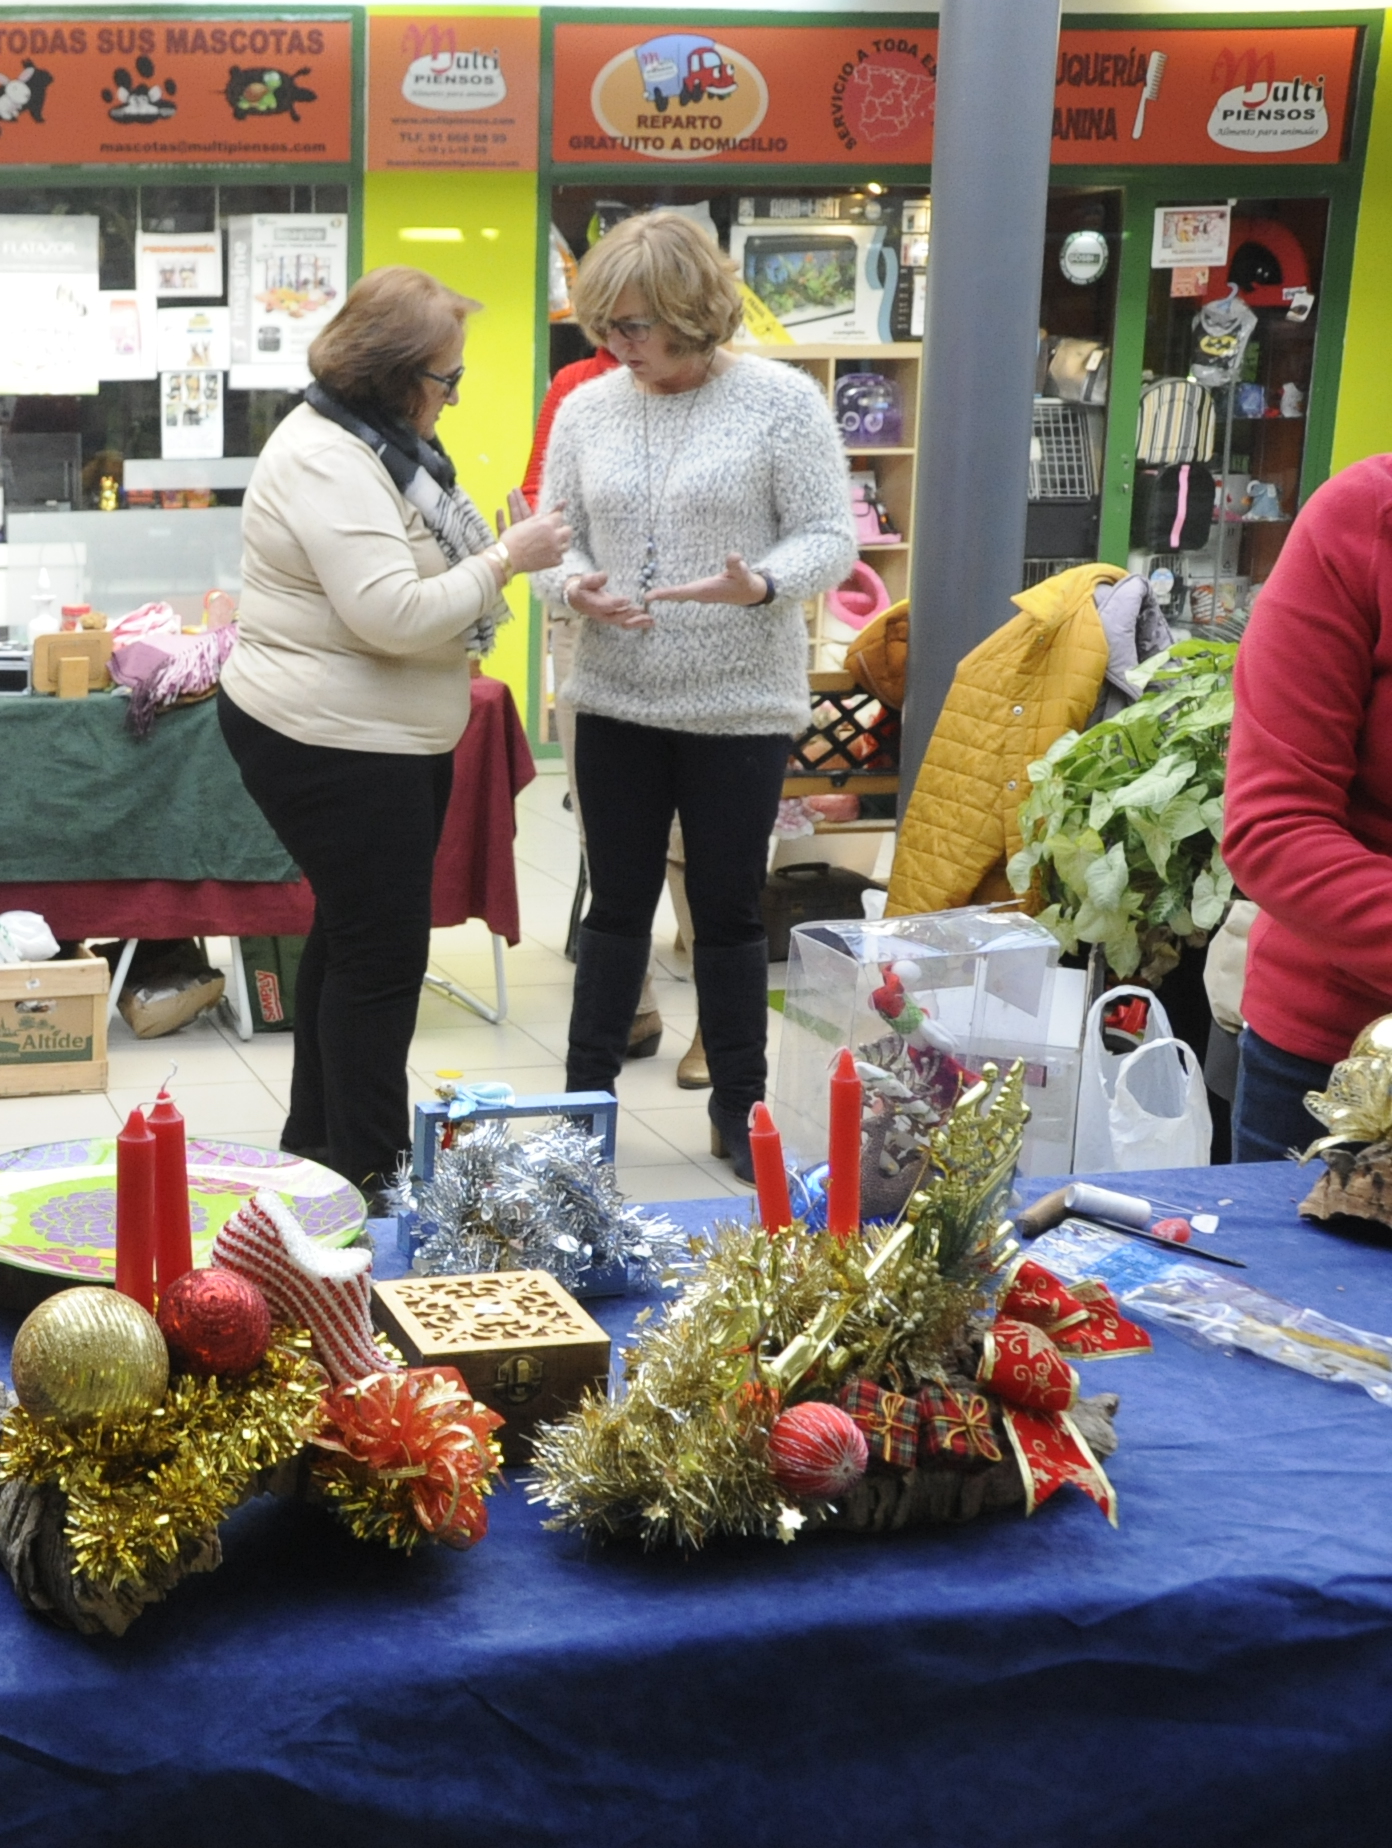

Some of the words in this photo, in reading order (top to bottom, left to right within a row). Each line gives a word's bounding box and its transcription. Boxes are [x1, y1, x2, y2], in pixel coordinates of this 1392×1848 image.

[97, 28, 157, 54] SUS
[165, 28, 325, 55] MASCOTAS
[414, 75, 494, 85] PIENSOS
[831, 62, 857, 150] SERVICIO
[857, 49, 869, 63] A
[872, 38, 919, 58] TODA
[636, 114, 723, 131] REPARTO
[1222, 109, 1316, 121] PIENSOS
[1256, 129, 1278, 138] para
[568, 136, 665, 152] GRATUITO
[670, 137, 684, 151] A
[688, 137, 788, 153] DOMICILIO
